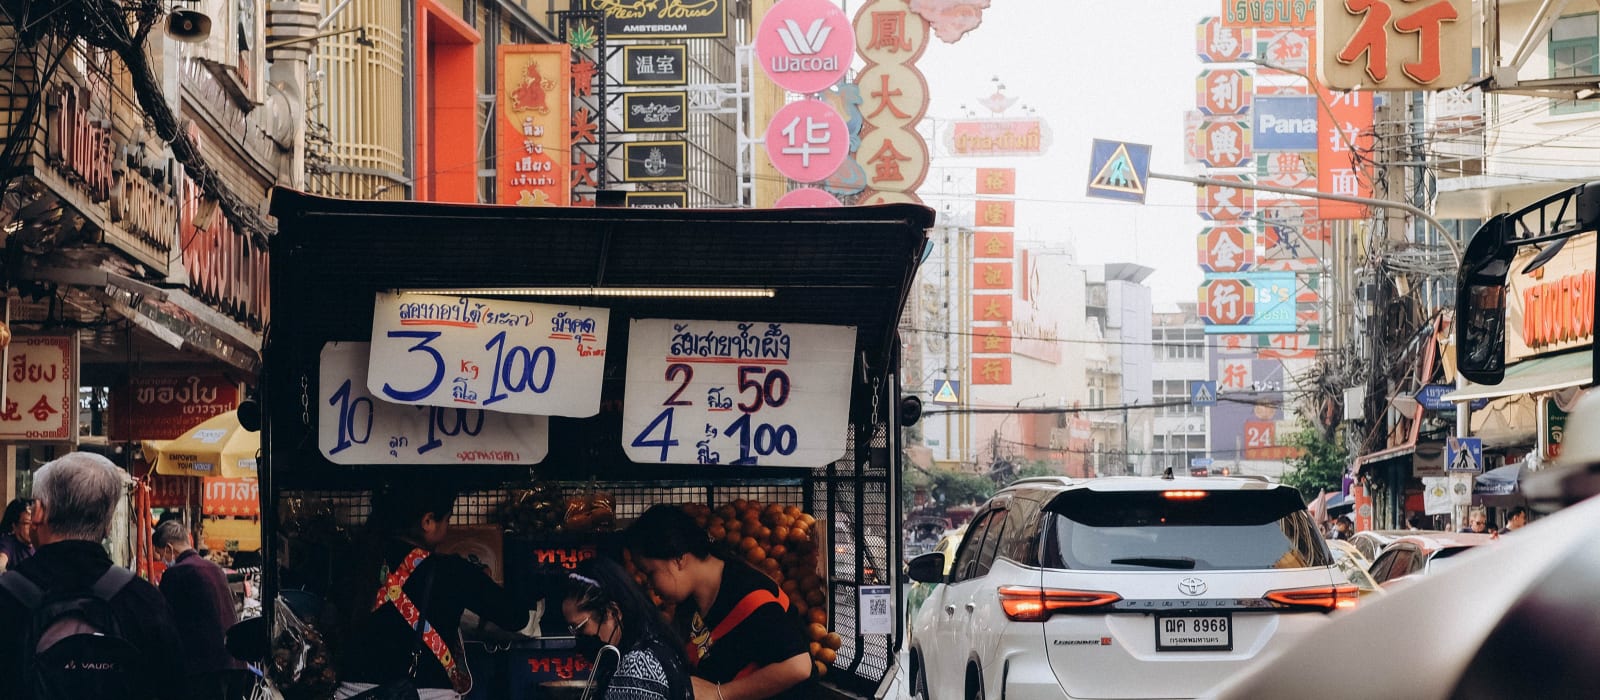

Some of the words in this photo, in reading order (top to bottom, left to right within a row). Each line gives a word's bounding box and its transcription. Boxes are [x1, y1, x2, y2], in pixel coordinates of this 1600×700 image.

[623, 24, 688, 32] AMSTERDAM
[635, 55, 675, 75] 温室
[772, 56, 838, 73] Wacoal
[866, 10, 913, 203] 鳳大金
[1259, 113, 1317, 134] Pana
[782, 116, 831, 168] 华
[671, 324, 791, 360] ส้มสายน้ำผึ้ง
[383, 331, 446, 402] 3
[482, 330, 556, 405] 100
[137, 376, 217, 403] ทองใบ
[662, 363, 694, 406] 2
[737, 365, 791, 413] 50
[329, 379, 373, 456] 10
[631, 407, 679, 462] 4
[723, 411, 798, 466] 100
[1248, 427, 1271, 447] 24
[1193, 618, 1227, 633] 8968
